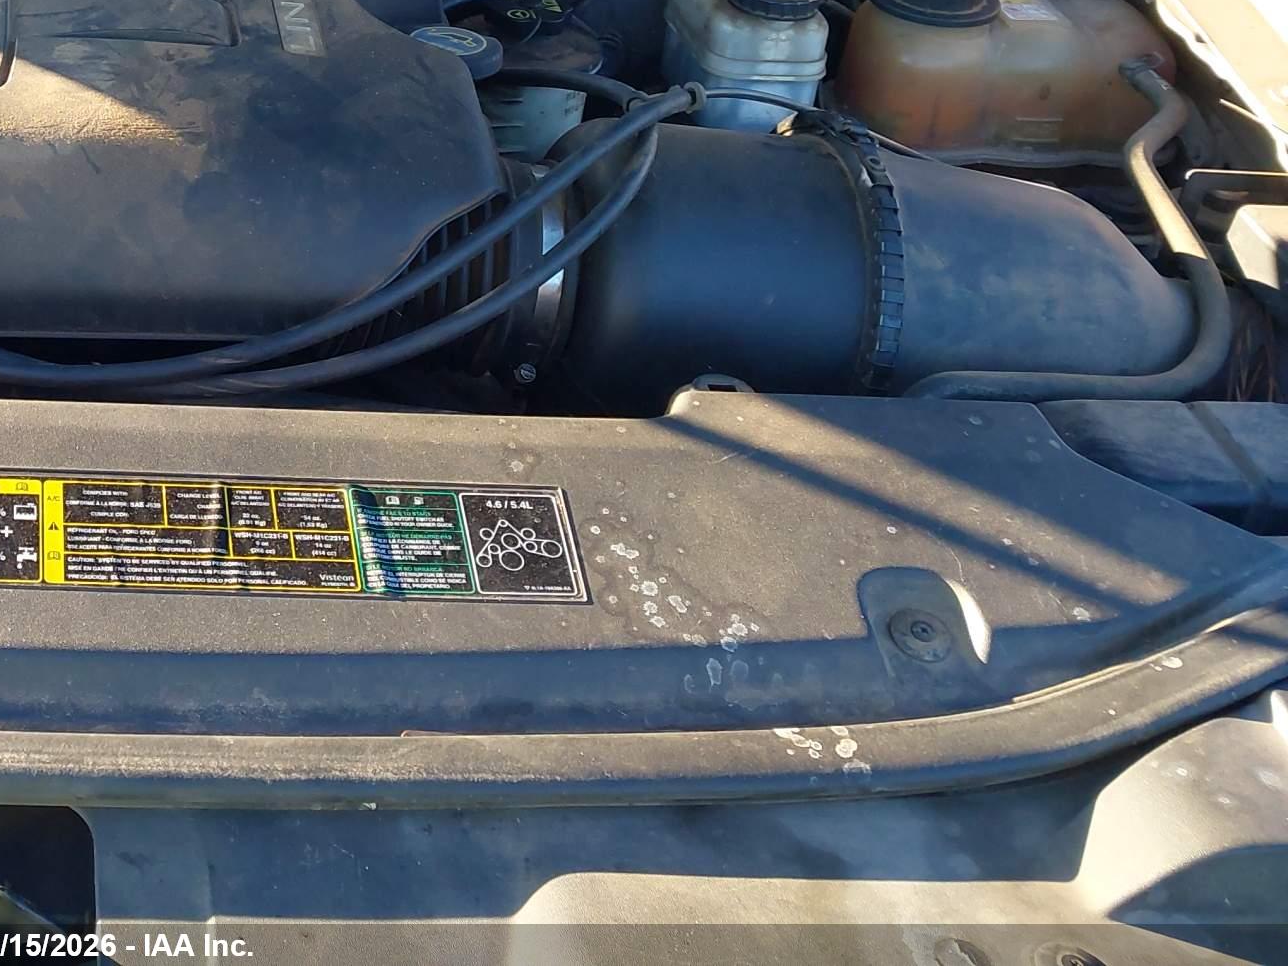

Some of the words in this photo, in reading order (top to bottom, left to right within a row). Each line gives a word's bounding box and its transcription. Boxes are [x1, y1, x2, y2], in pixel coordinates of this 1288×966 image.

[486, 500, 502, 508] 4.6
[510, 501, 533, 509] 5.4L
[319, 573, 354, 581] Visteon
